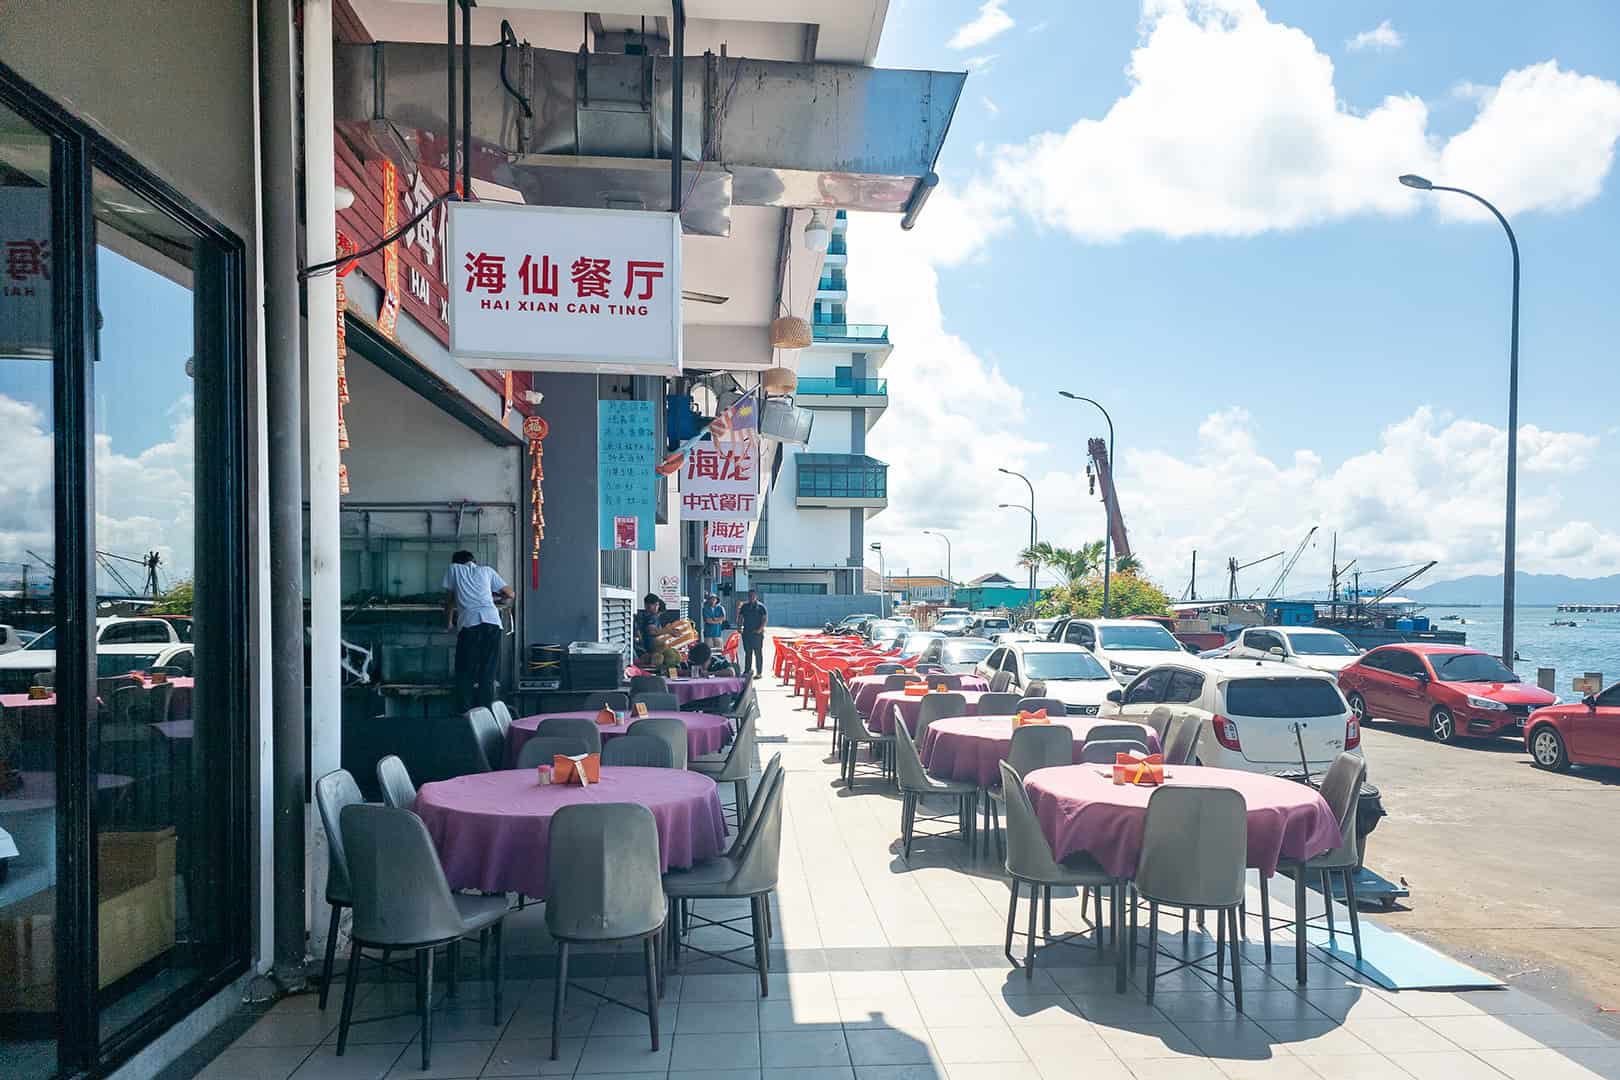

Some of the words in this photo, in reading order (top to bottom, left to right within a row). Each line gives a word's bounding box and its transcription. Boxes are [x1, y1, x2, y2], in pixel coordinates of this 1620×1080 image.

[410, 267, 430, 306] HAI
[464, 252, 664, 300] 海仙餐厅
[481, 299, 510, 311] HAI
[518, 301, 559, 312] XIAN
[567, 303, 600, 314] CAN
[608, 304, 649, 315] TING
[687, 448, 752, 481] 海龙
[683, 493, 755, 511] 中式餐厅
[712, 521, 745, 538] 海龙
